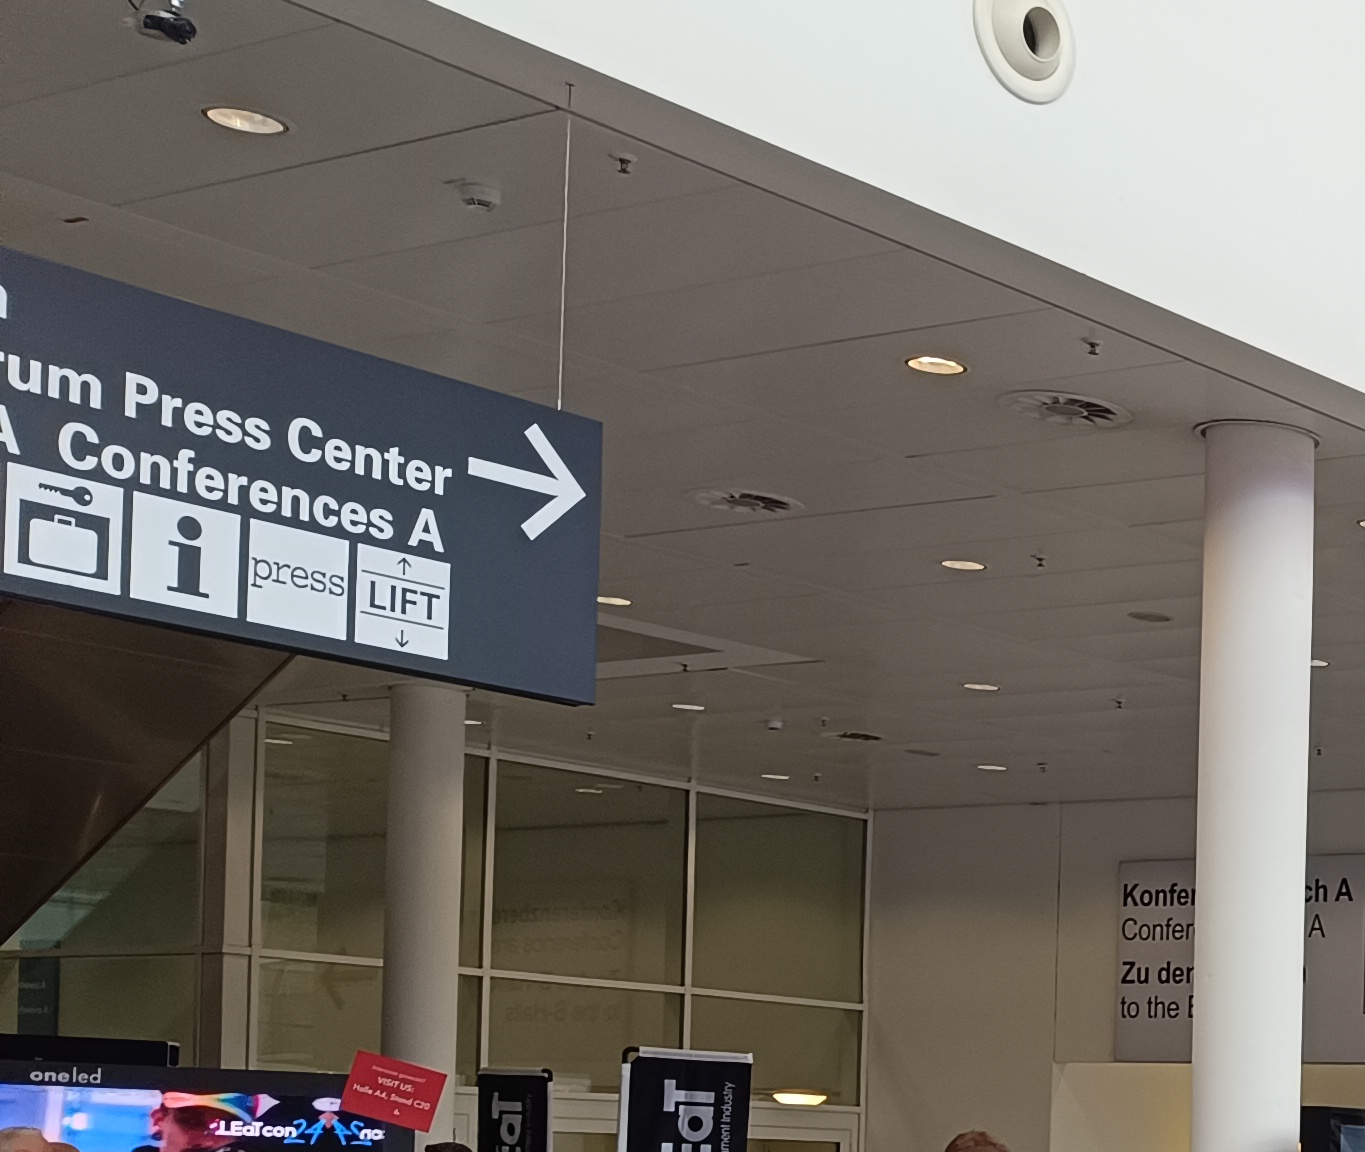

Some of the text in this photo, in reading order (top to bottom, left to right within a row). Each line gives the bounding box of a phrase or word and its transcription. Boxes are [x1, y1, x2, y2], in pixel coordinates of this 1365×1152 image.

[124, 371, 271, 451] Press
[287, 417, 452, 495] Center
[58, 422, 394, 540] Conferences
[408, 508, 444, 552] A
[250, 553, 346, 598] press
[368, 579, 441, 620] LIFT
[1335, 877, 1354, 902] A
[1307, 913, 1326, 938] A
[1120, 961, 1150, 985] Zu
[1120, 995, 1140, 1019] to
[1147, 995, 1180, 1019] the
[719, 1081, 736, 1122] Industry
